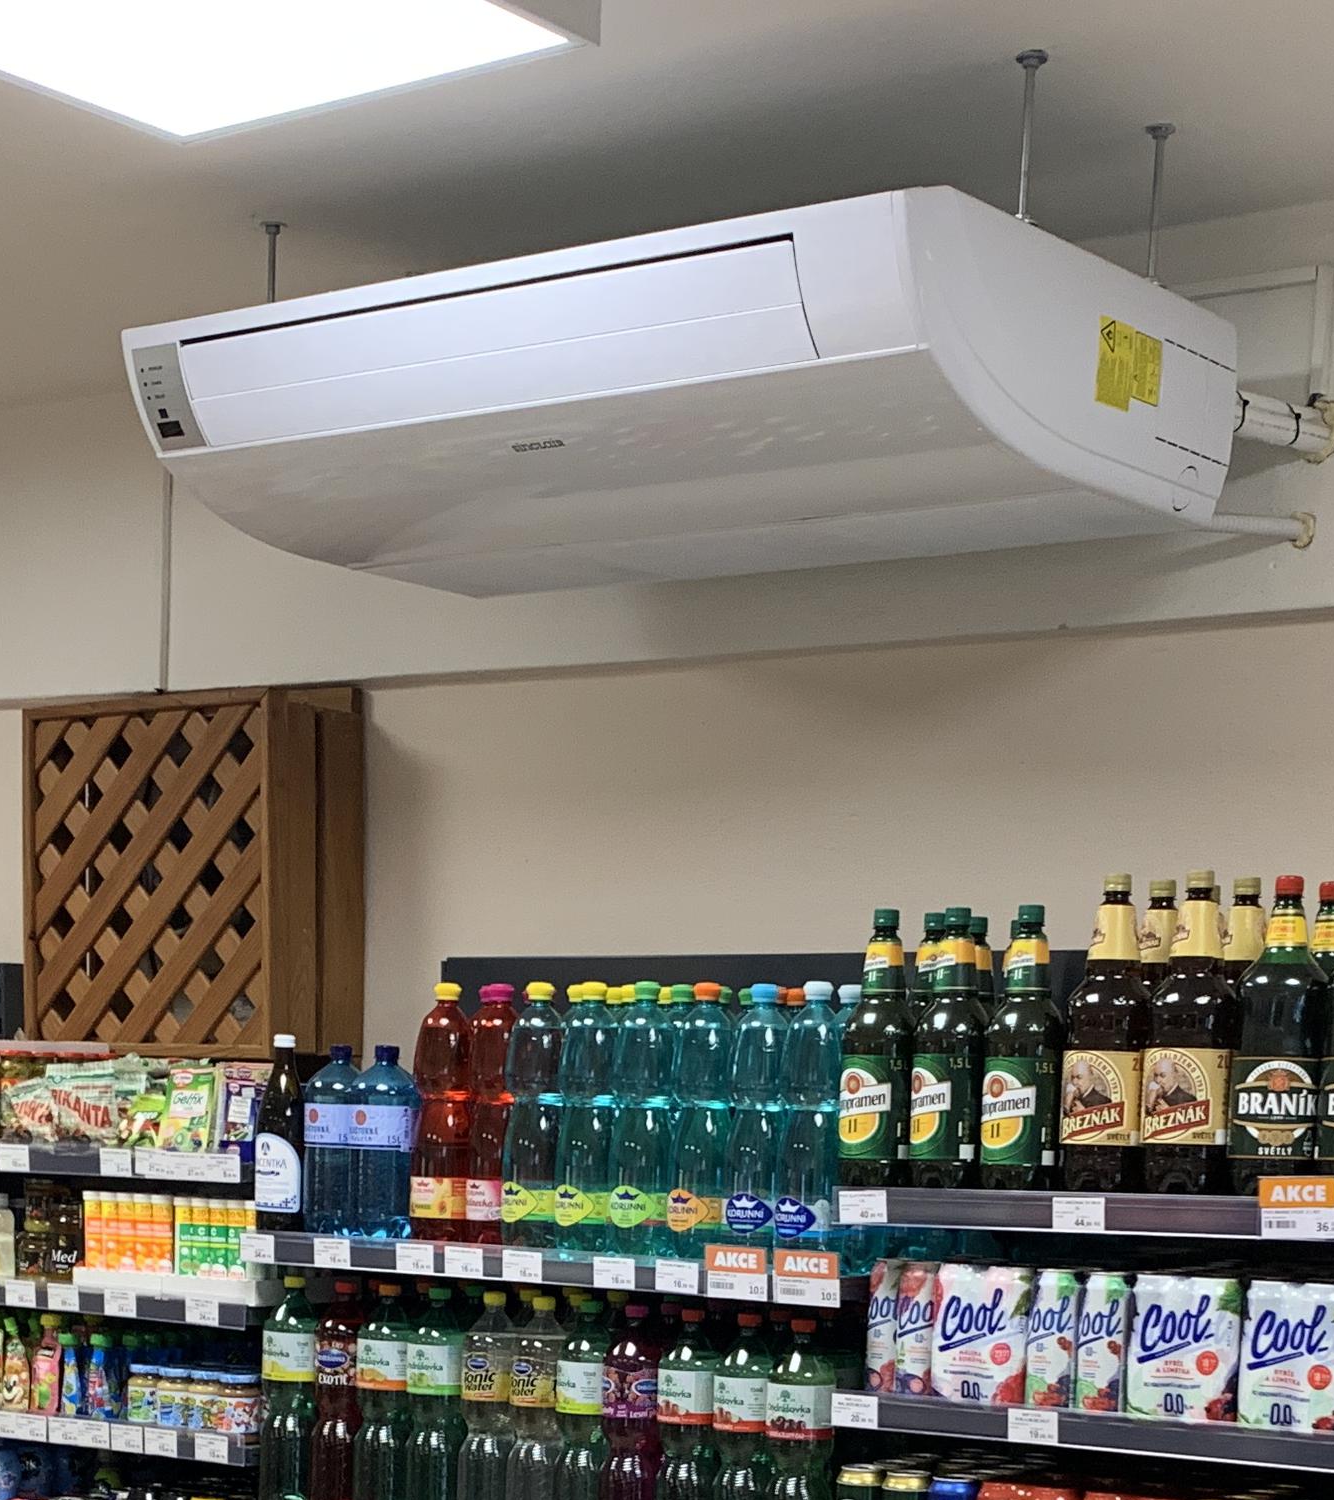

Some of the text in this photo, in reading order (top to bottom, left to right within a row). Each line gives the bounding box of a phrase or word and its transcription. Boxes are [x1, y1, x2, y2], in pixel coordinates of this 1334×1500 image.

[1237, 1088, 1317, 1117] BRANÍK
[1145, 1105, 1206, 1134] BŘEZŇÁK
[1258, 1145, 1293, 1159] SVĚTLÝ
[1270, 1184, 1326, 1202] AKCE
[715, 1252, 757, 1269] AKCE
[784, 1256, 829, 1273] AKCE
[941, 1288, 1004, 1342] Cool
[1139, 1294, 1212, 1352] Cool
[1251, 1304, 1328, 1359] Cool
